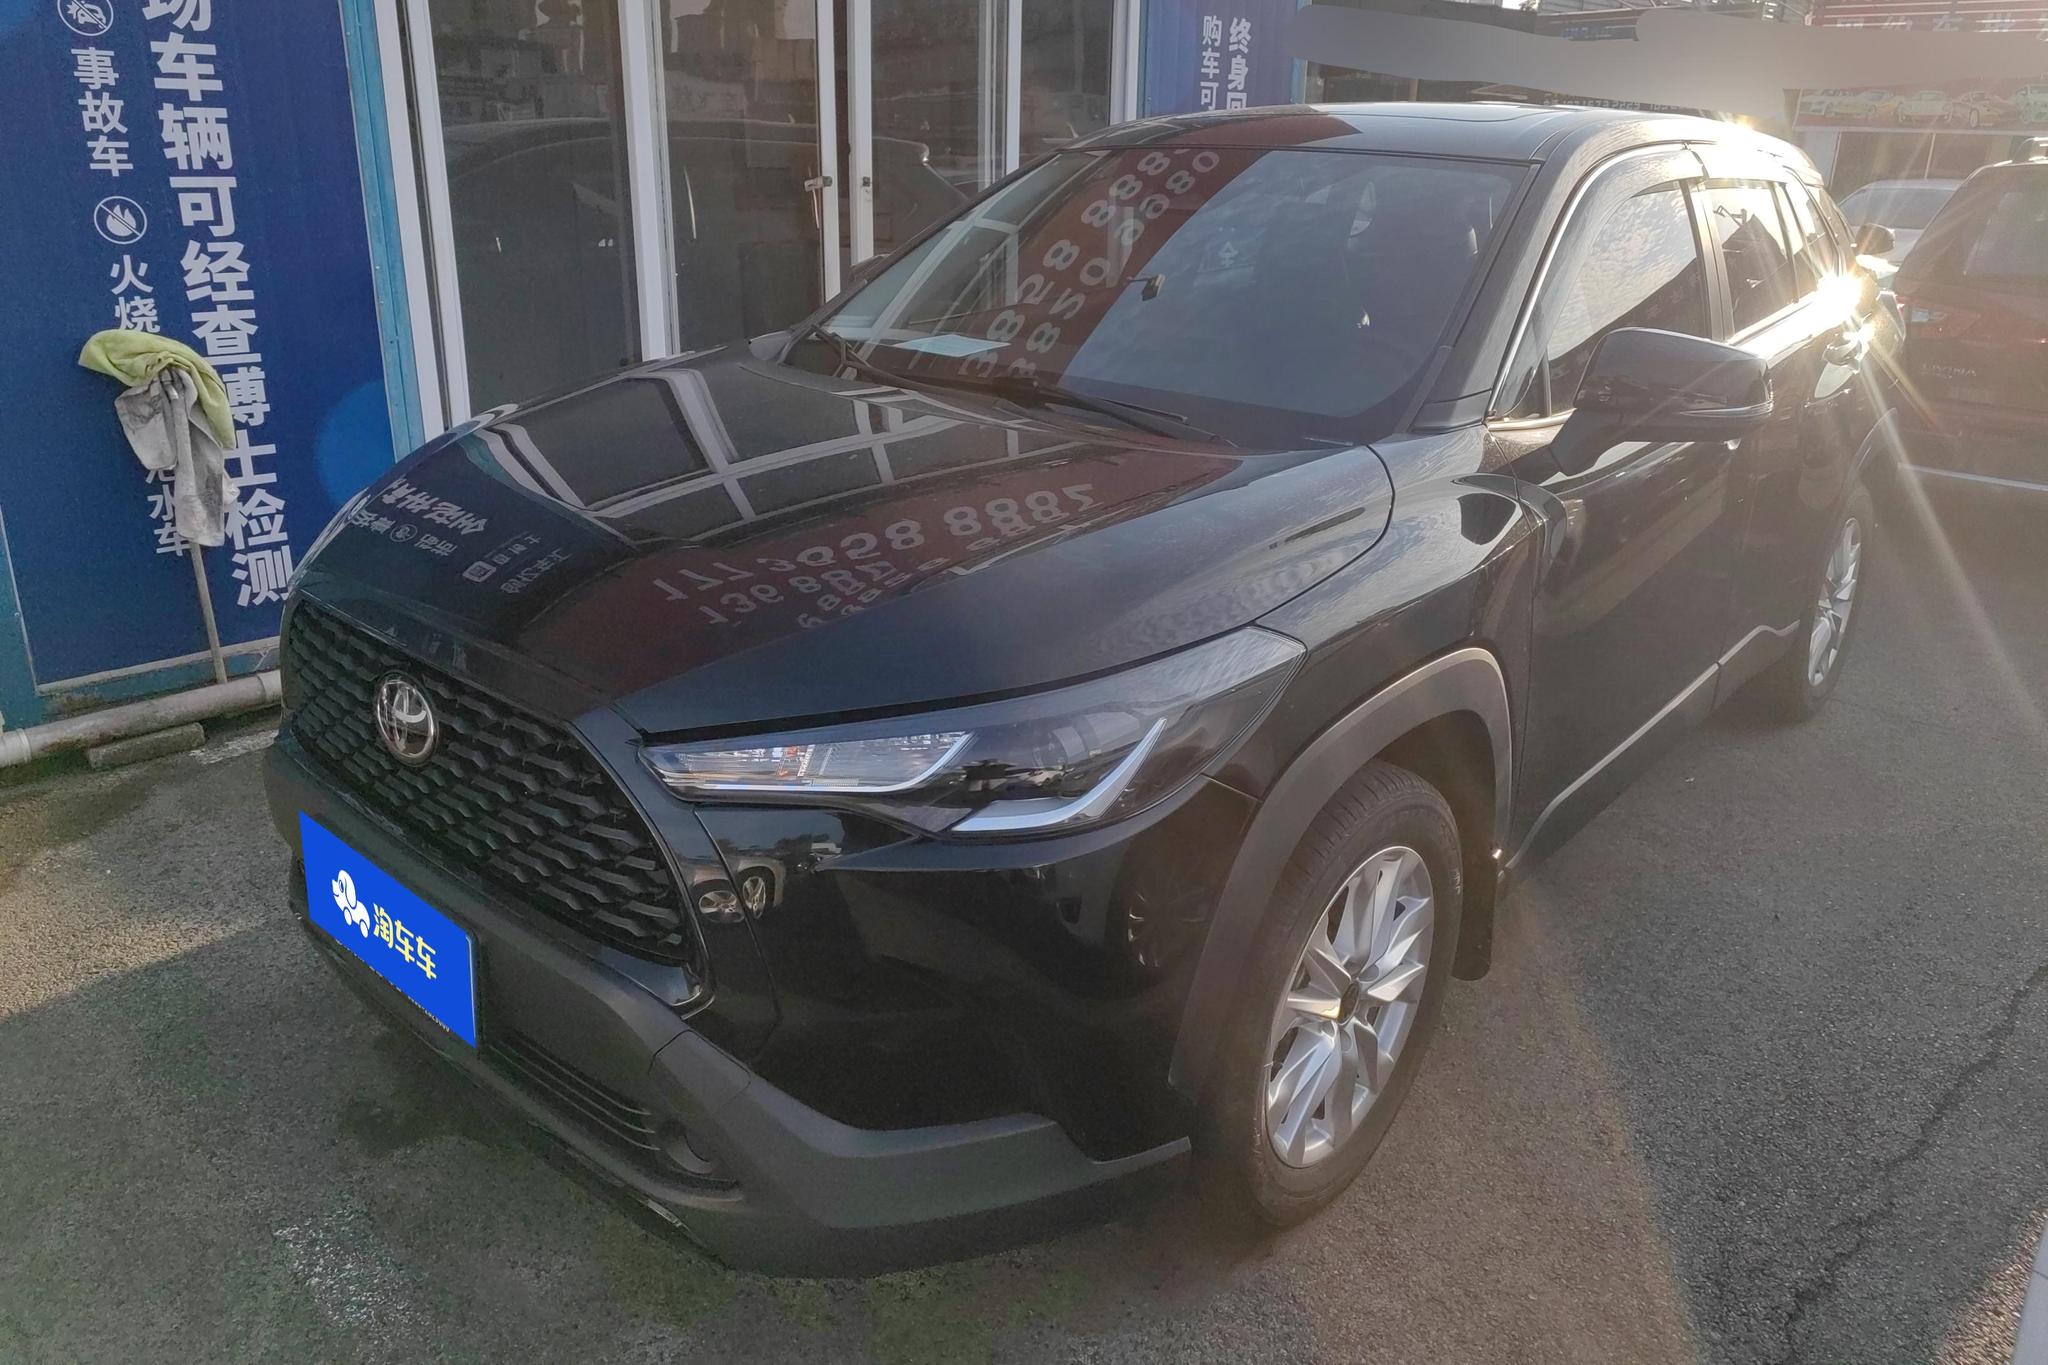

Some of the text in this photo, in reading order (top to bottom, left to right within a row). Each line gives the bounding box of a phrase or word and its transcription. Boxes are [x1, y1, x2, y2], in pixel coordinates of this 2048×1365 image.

[1200, 15, 1222, 111] 购车可
[70, 47, 134, 177] 事故车
[145, 469, 194, 556] 水车
